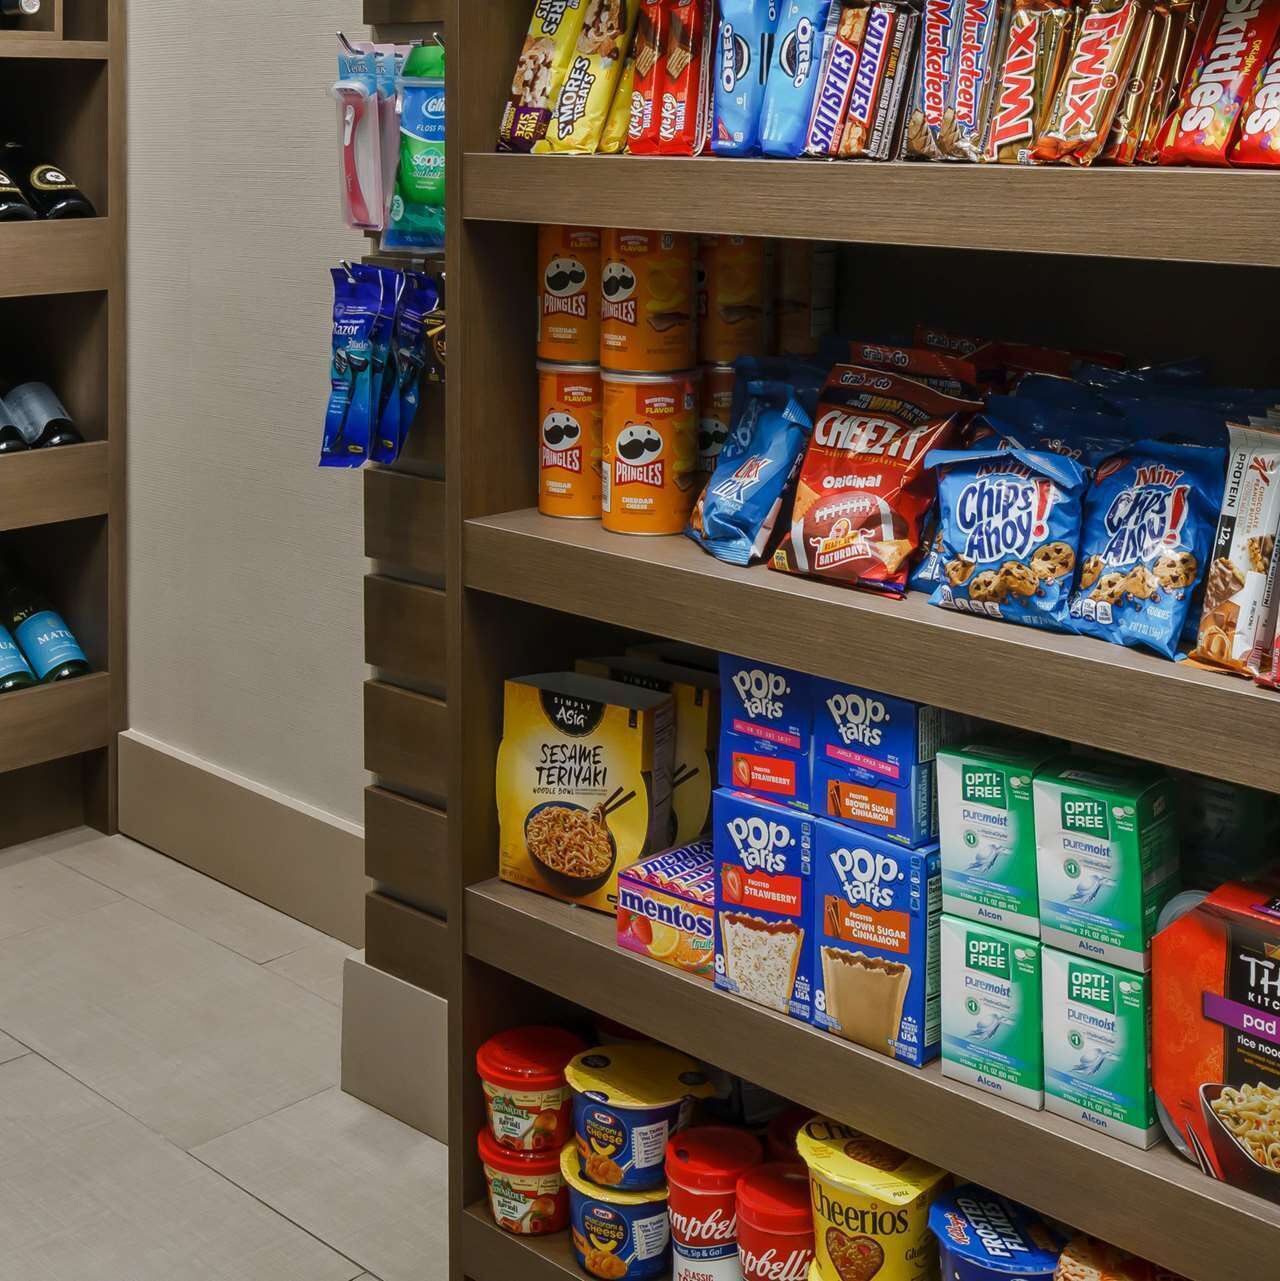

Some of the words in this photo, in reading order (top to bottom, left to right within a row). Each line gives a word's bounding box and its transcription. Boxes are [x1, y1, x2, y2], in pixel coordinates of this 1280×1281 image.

[721, 23, 735, 93] OREO
[793, 17, 812, 88] OREO
[345, 58, 368, 73] Venus
[851, 9, 887, 119] SATISFIES
[559, 56, 591, 139] S'MORES
[574, 74, 594, 118] TREATS
[811, 44, 855, 152] SATISFIES
[416, 124, 435, 132] FLOSS
[515, 113, 527, 137] SIZE
[525, 112, 539, 139] KING
[874, 377, 891, 390] Go
[1135, 468, 1184, 487] Mini
[1227, 453, 1246, 508] PROTEIN
[959, 480, 1035, 530] Chips
[1106, 486, 1171, 535] Chips
[553, 696, 591, 710] SIMPLY
[743, 695, 783, 719] tarts
[556, 707, 586, 728] Asia
[838, 721, 883, 747] tarts
[540, 744, 604, 766] SESAME
[535, 766, 608, 788] TERIYAKI
[751, 771, 790, 785] STRAWBERRY
[966, 773, 1001, 787] OPTI-
[532, 787, 557, 795] NOODLE
[557, 787, 575, 795] BOWL
[967, 785, 1001, 799] FREE
[845, 798, 871, 810] BROWN
[871, 803, 894, 815] SUGAR
[851, 808, 888, 822] CINNAMON
[963, 809, 1008, 826] puremoist
[1066, 814, 1103, 829] FREE
[744, 887, 797, 906] STRAWBERRY
[619, 887, 713, 938] mentos
[978, 908, 1002, 922] Alcon
[845, 919, 875, 933] BROWN
[876, 925, 906, 940] SUGAR
[852, 930, 900, 947] CINNAMON
[1078, 941, 1105, 955] Alcon
[715, 954, 725, 974] 8
[795, 991, 810, 1002] USA
[814, 989, 825, 1011] 8
[1243, 1012, 1276, 1035] pad
[1237, 1033, 1256, 1050] rice
[893, 1190, 910, 1198] PULL
[814, 1178, 909, 1236] Cheerios
[585, 1222, 624, 1240] Cheese
[960, 1198, 1002, 1257] FROSTED
[982, 1201, 1024, 1253] FLAKES
